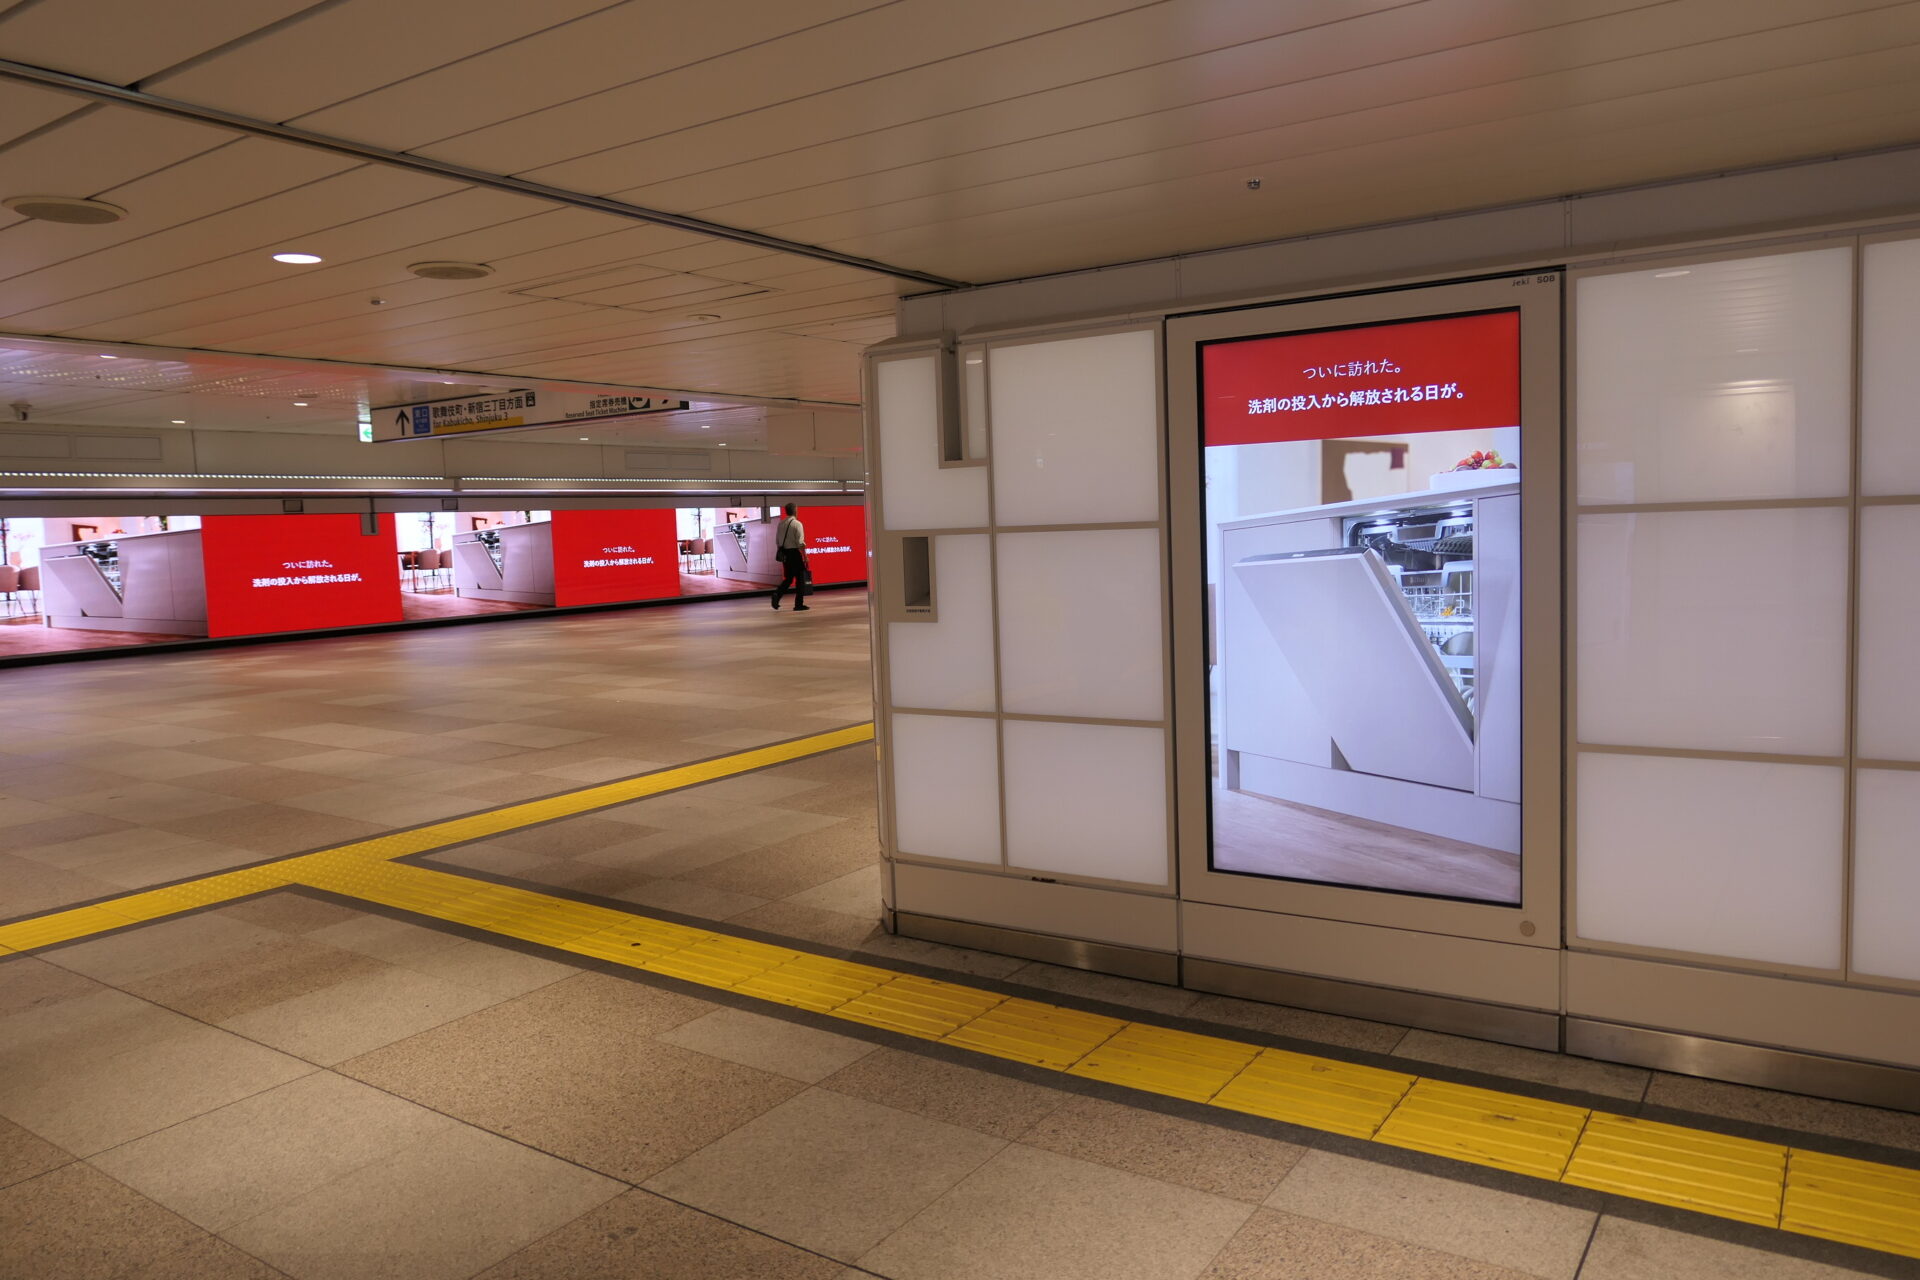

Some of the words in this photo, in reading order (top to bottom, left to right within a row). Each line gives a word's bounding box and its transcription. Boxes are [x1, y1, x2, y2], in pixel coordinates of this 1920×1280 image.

[1303, 358, 1401, 380] ついに訪れた。
[1248, 382, 1465, 415] 洗剤の投入から解放される日が。
[282, 560, 333, 569] ついに訪れた。
[252, 573, 362, 588] 洗剤の投入から解放される日が。
